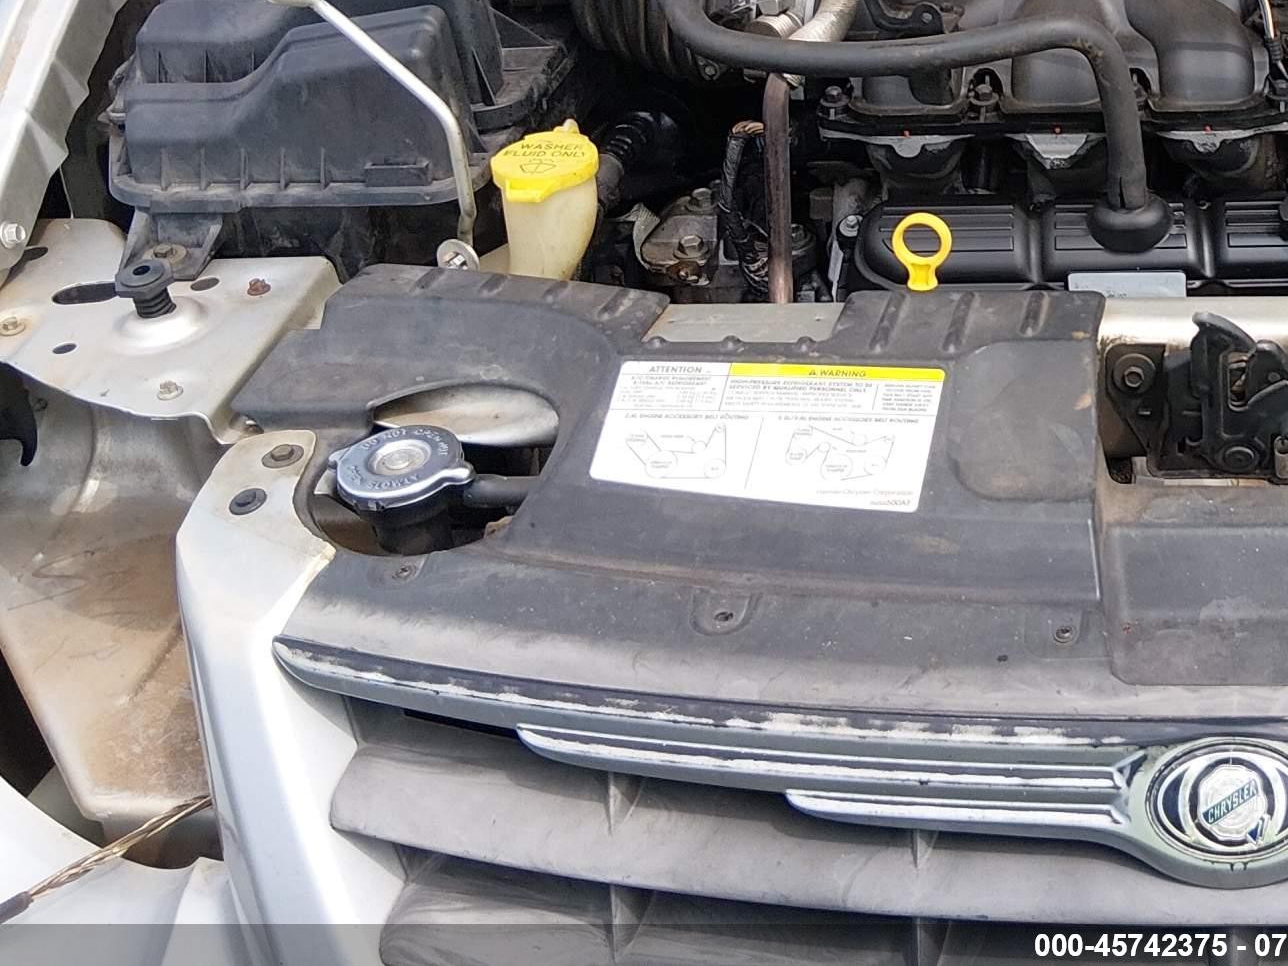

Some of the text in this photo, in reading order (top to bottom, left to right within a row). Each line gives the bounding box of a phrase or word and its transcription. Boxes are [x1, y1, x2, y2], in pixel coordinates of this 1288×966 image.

[521, 143, 583, 151] WASHER
[819, 370, 867, 378] WARNING
[1208, 779, 1257, 823] CHRYSLER
